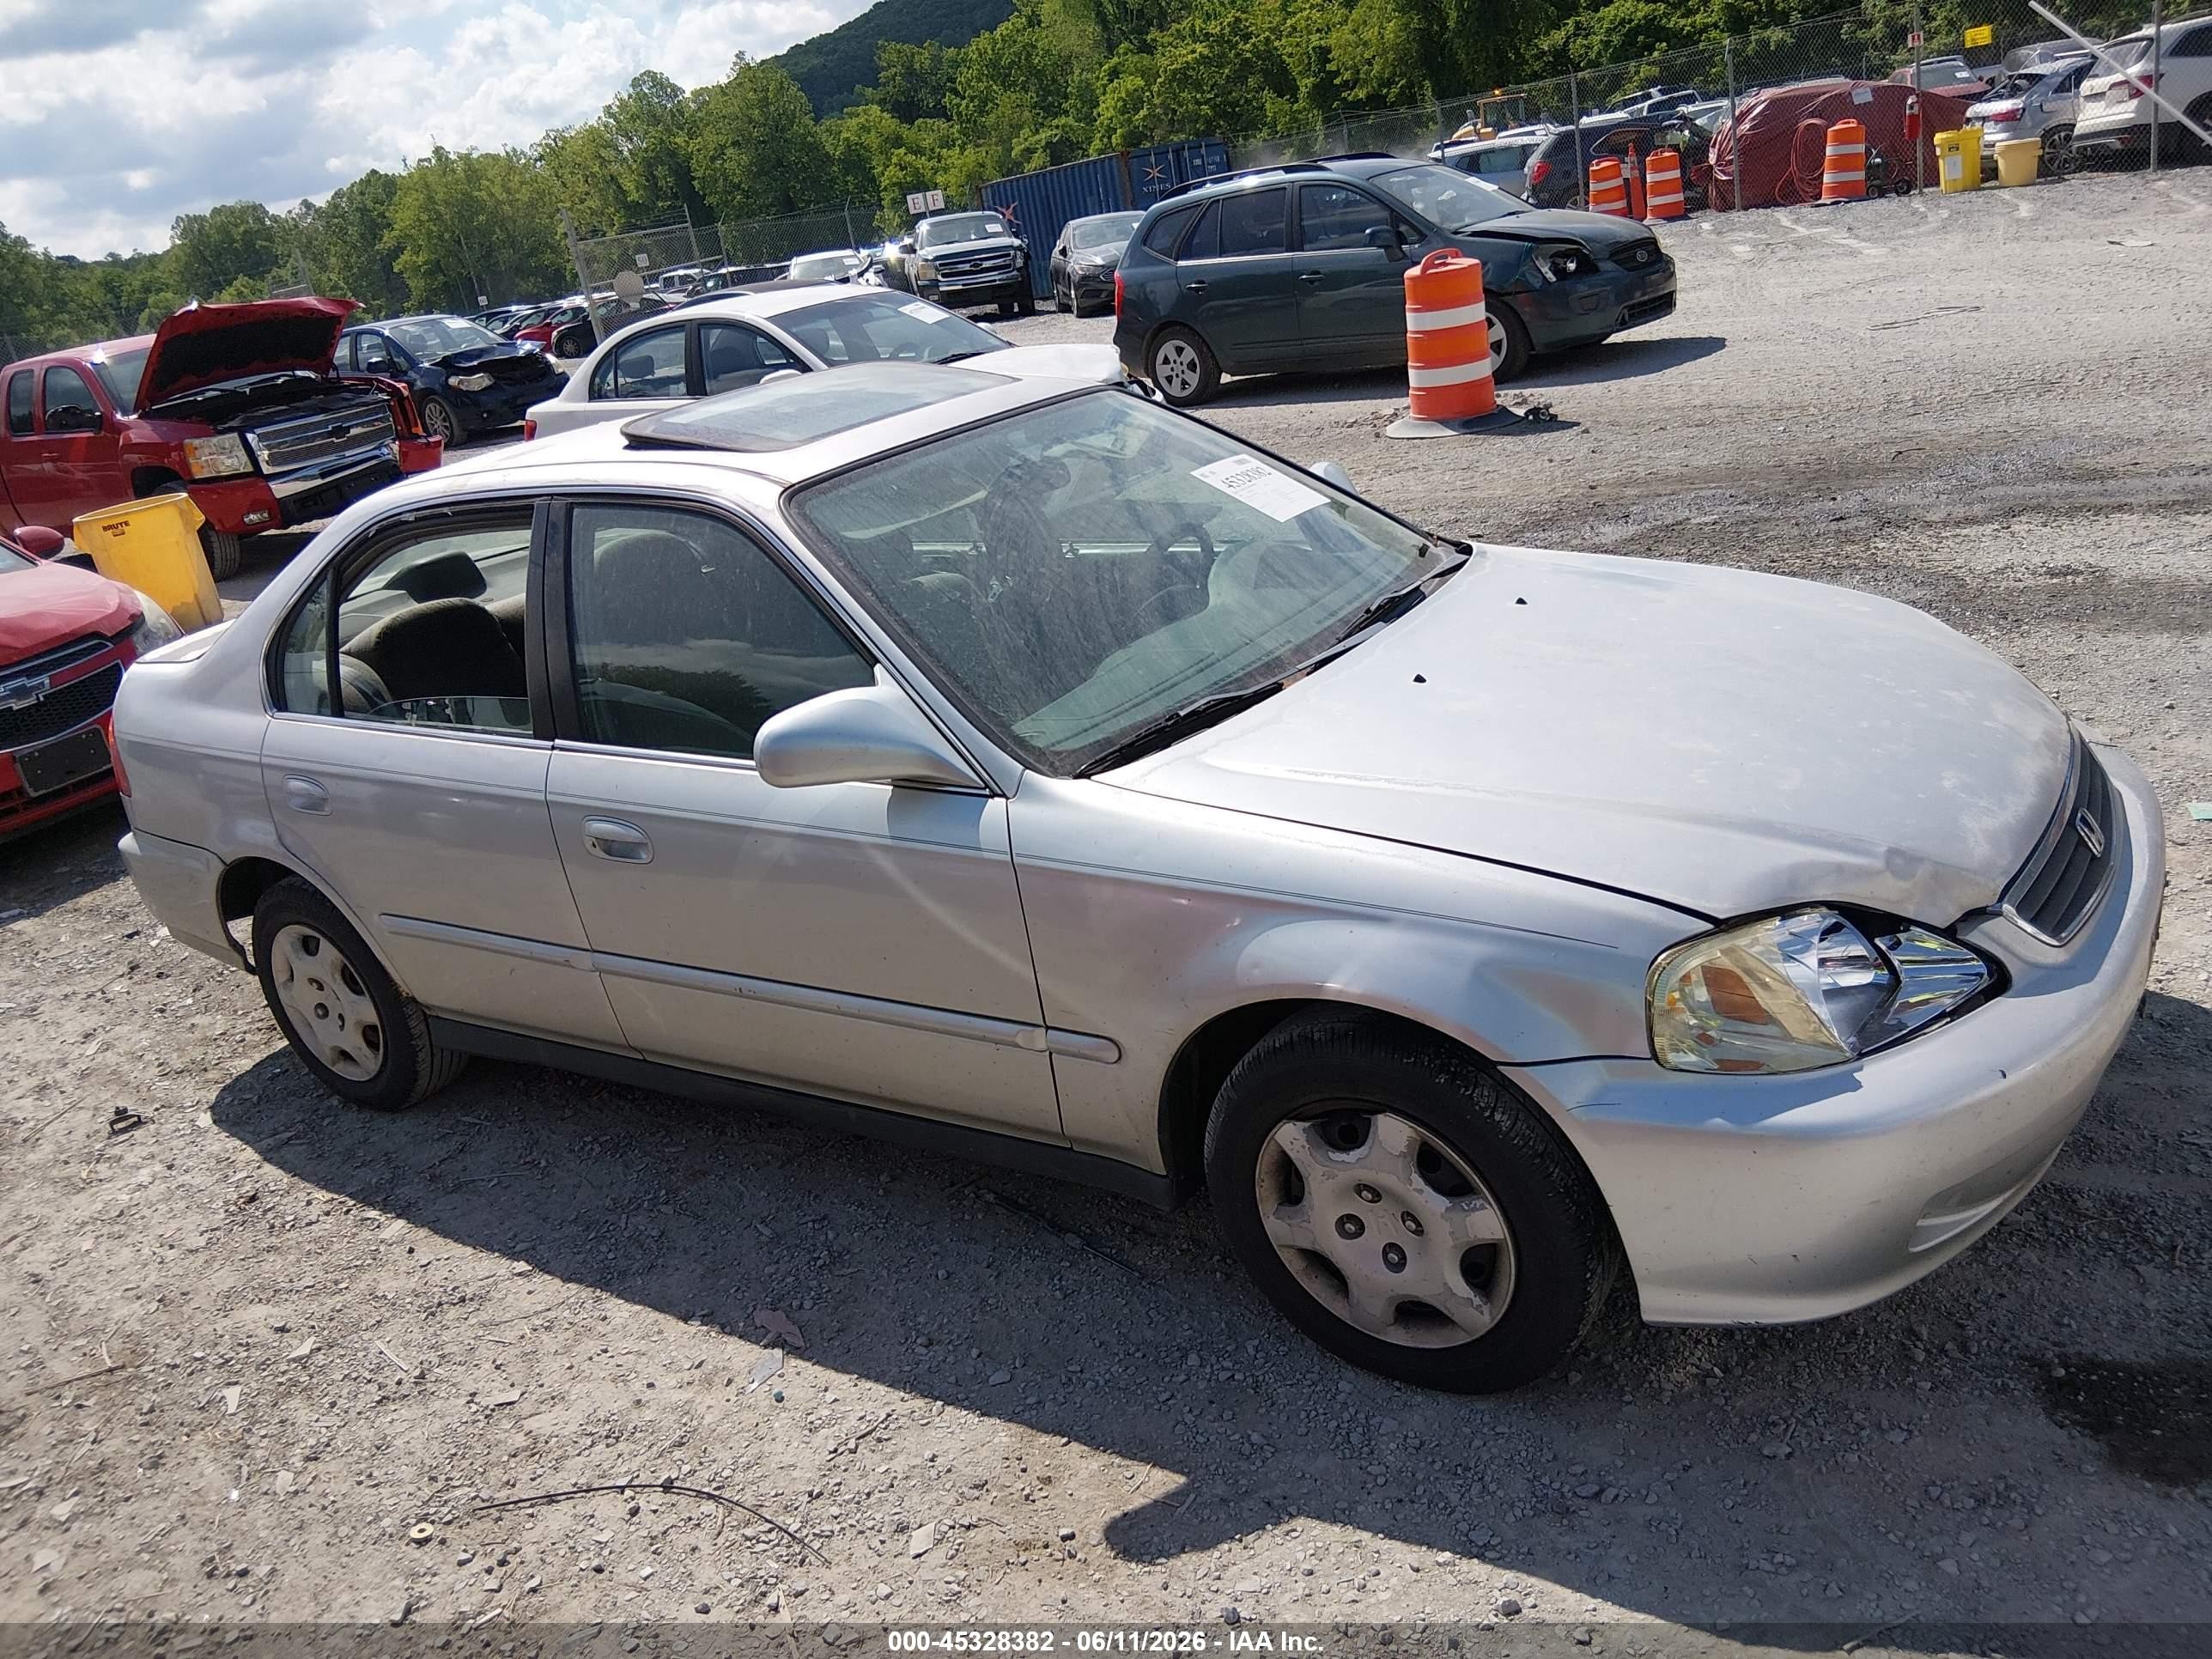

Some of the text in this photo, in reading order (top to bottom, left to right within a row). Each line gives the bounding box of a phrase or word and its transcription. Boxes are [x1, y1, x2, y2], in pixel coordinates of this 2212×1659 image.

[911, 197, 921, 210] E
[931, 193, 939, 207] F
[1220, 466, 1273, 489] 45328382
[101, 520, 131, 532] BRUTE
